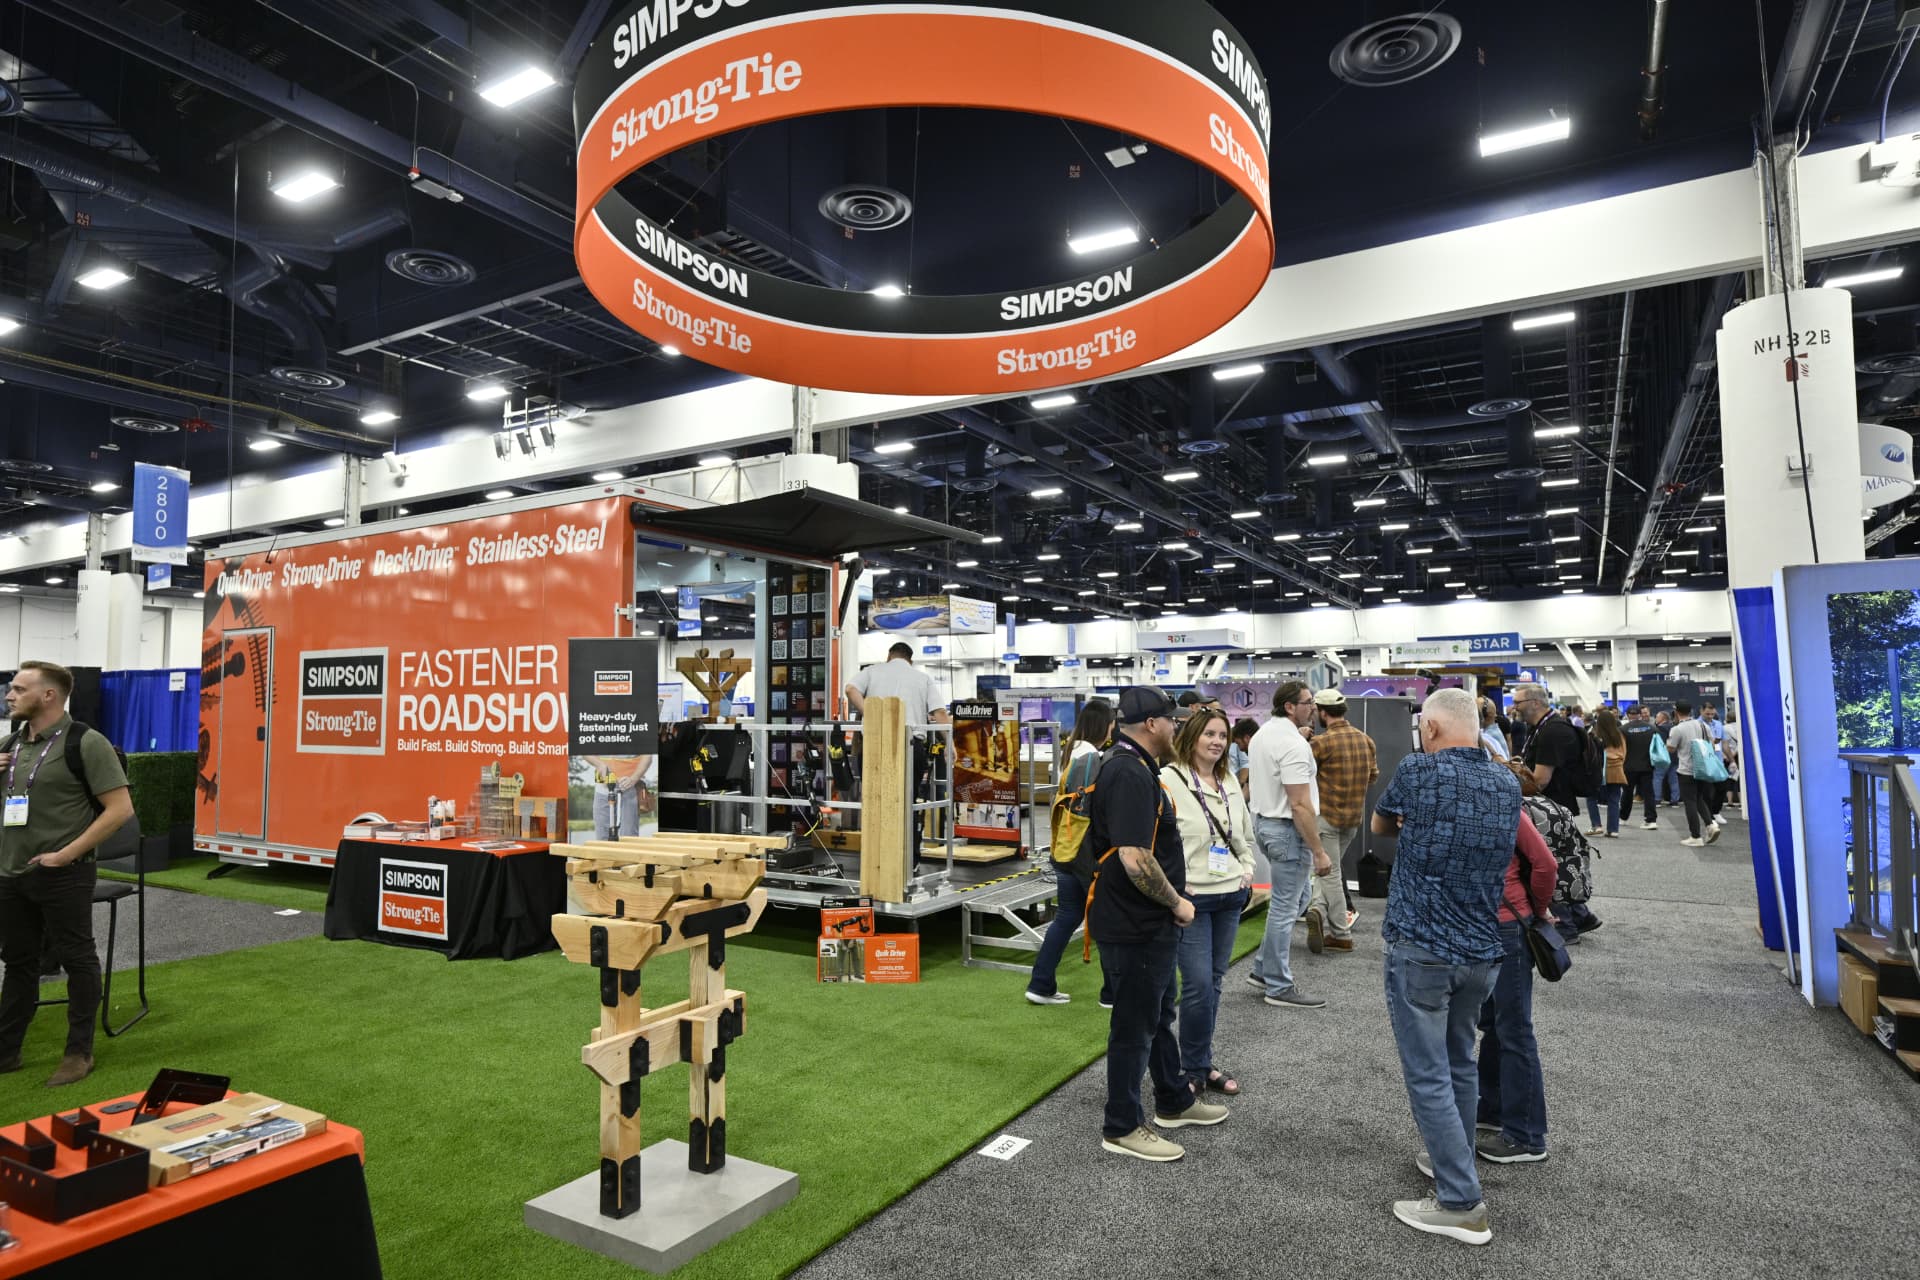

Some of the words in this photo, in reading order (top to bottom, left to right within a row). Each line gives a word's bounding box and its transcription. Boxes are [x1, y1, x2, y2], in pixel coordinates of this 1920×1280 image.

[610, 52, 803, 160] Strong-Tie
[635, 218, 749, 298] SIMPSON
[1000, 266, 1133, 321] SIMPSON
[632, 278, 752, 354] Strong-Tie
[997, 326, 1137, 375] Strong-Tie
[155, 476, 168, 540] 2800
[308, 665, 378, 687] SIMPSON
[400, 644, 558, 688] FASTENER
[579, 712, 637, 722] Heavy-duty
[955, 704, 972, 716] Quik
[972, 704, 993, 715] Drive
[305, 710, 377, 737] Strong-Tie
[579, 722, 626, 733] fastening
[629, 722, 649, 733] just
[397, 738, 419, 752] Build
[421, 739, 442, 752] Fast.
[445, 739, 469, 753] Build
[471, 740, 505, 757] Strong.
[508, 741, 535, 755] Build
[579, 734, 596, 744] got
[598, 733, 632, 743] easier.
[385, 870, 440, 891] SIMPSON
[384, 901, 440, 925] Strong-Tie
